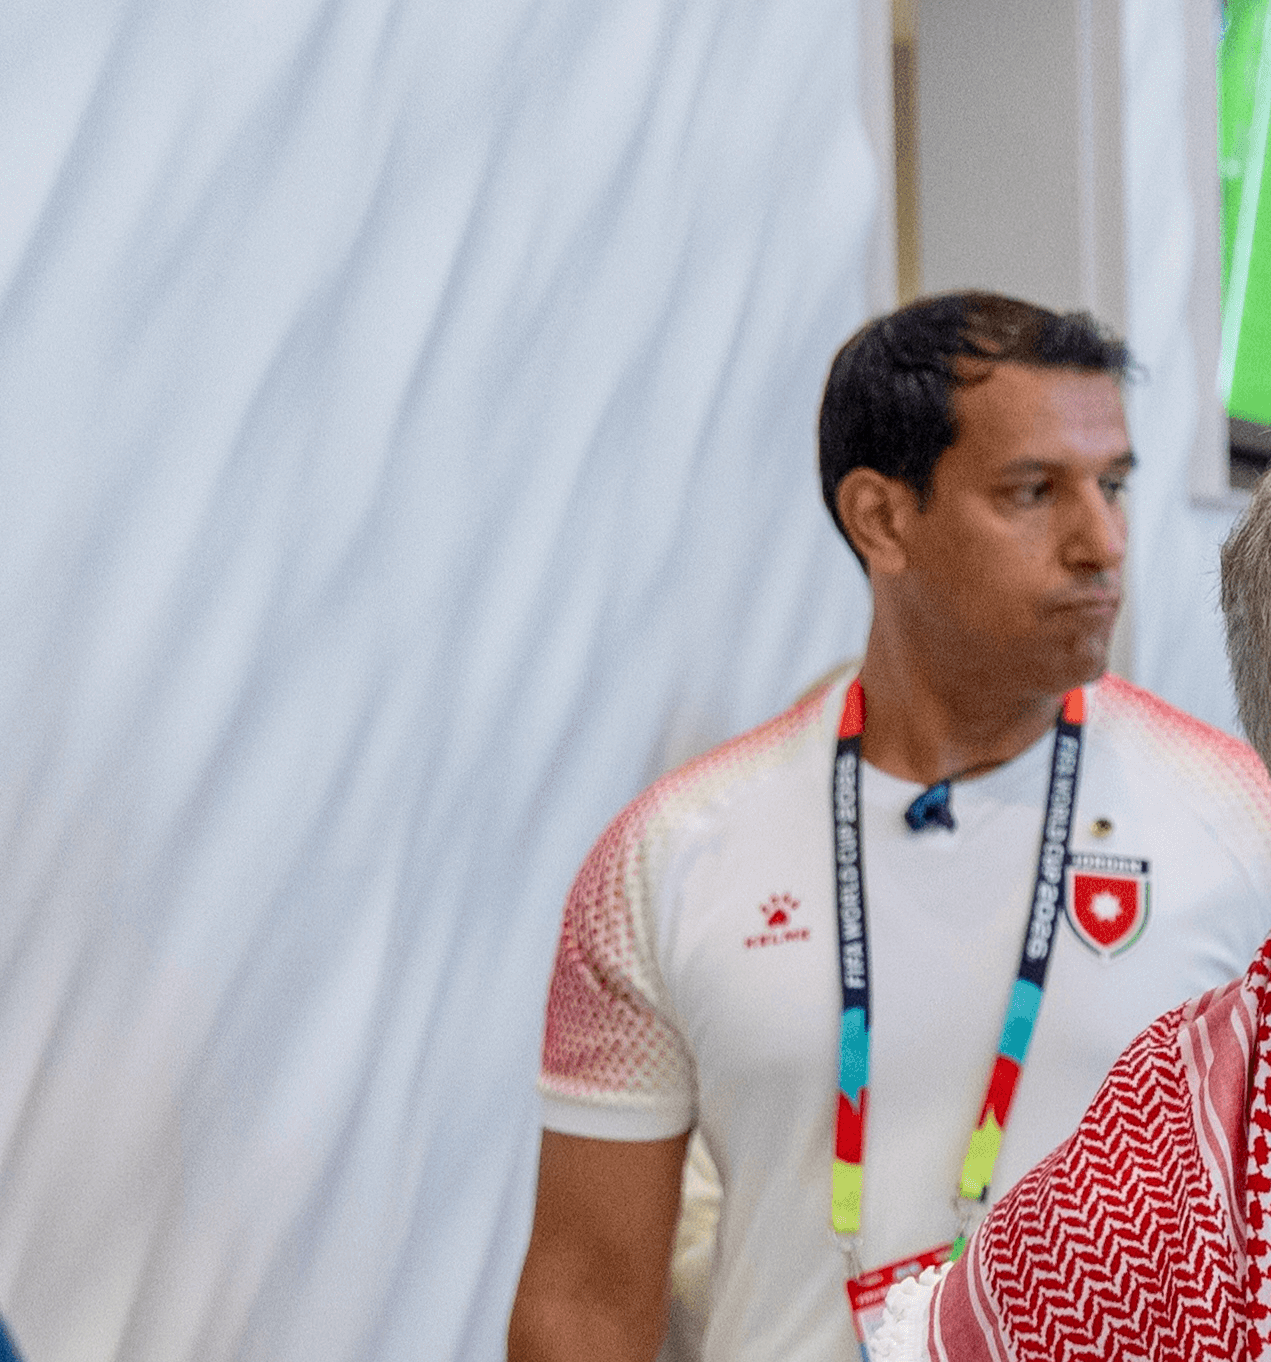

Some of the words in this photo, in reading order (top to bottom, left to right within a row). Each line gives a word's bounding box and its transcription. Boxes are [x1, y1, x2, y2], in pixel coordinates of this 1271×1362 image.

[836, 752, 857, 823] 2026
[837, 823, 859, 865] CUP
[1041, 842, 1066, 884] CUP
[837, 864, 863, 941] WORLD
[1026, 882, 1060, 961] 2026
[843, 941, 867, 989] FIFA
